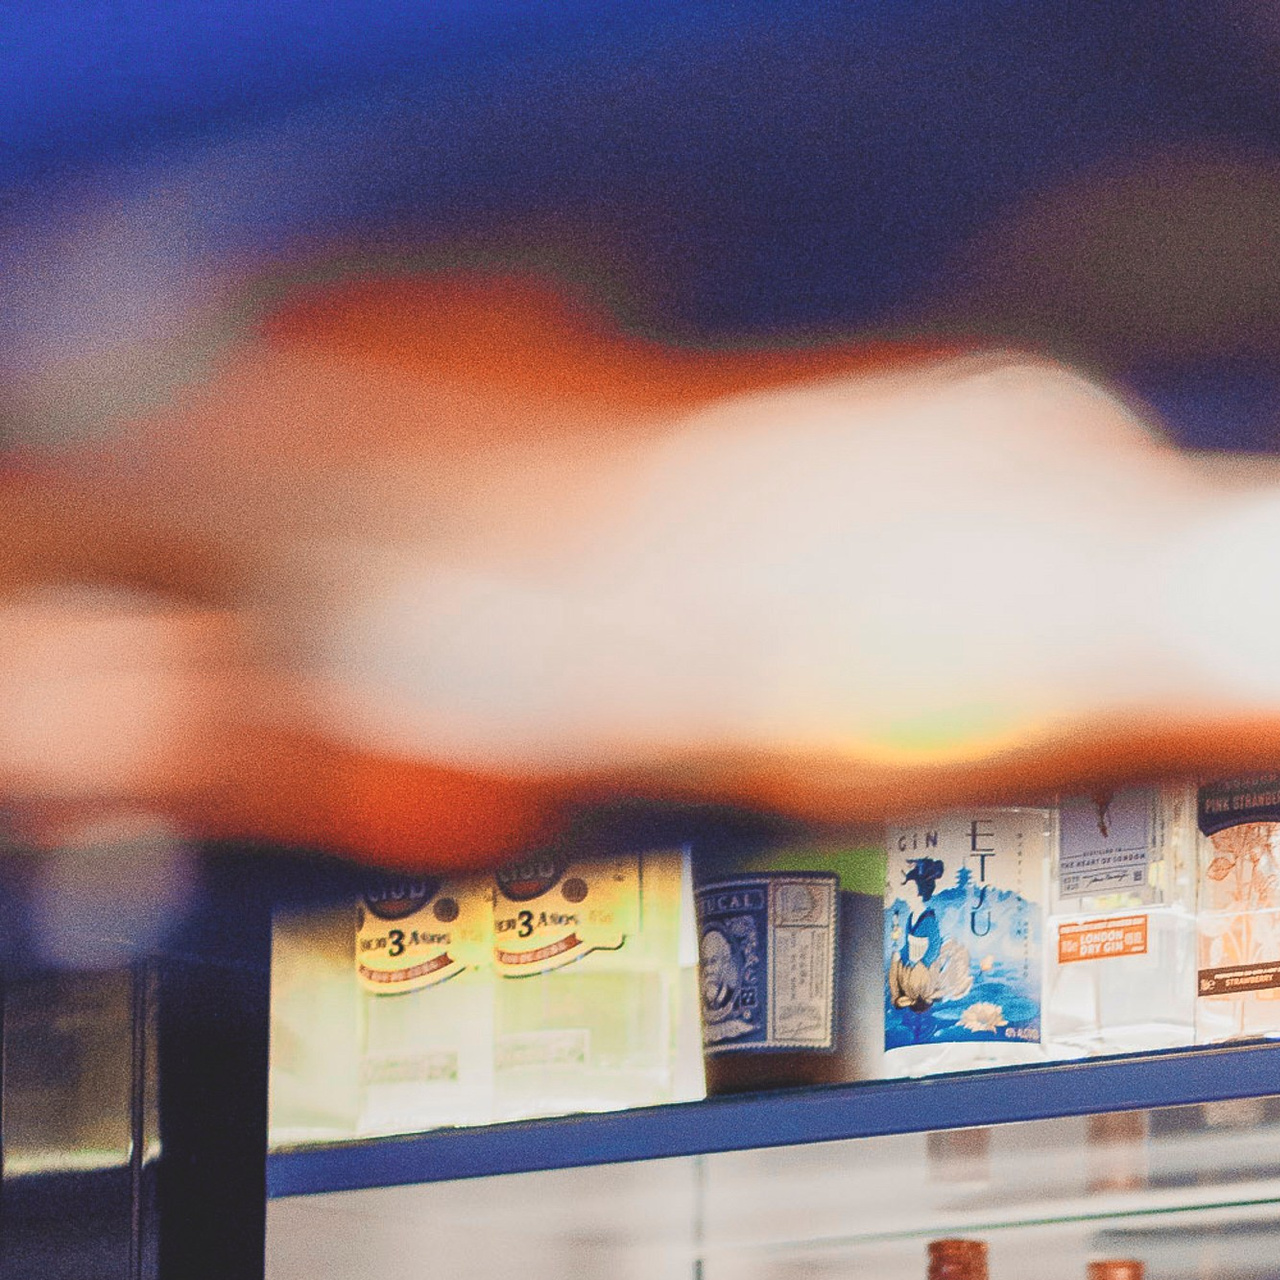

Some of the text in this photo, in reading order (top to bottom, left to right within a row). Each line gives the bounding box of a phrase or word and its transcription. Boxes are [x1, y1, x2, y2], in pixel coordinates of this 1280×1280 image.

[898, 831, 938, 851] GIN
[518, 910, 534, 937] 3
[388, 929, 405, 957] 3
[1079, 929, 1124, 944] LONDON
[1080, 941, 1124, 956] DRY GIN
[1225, 973, 1273, 988] STRAWBERRY
